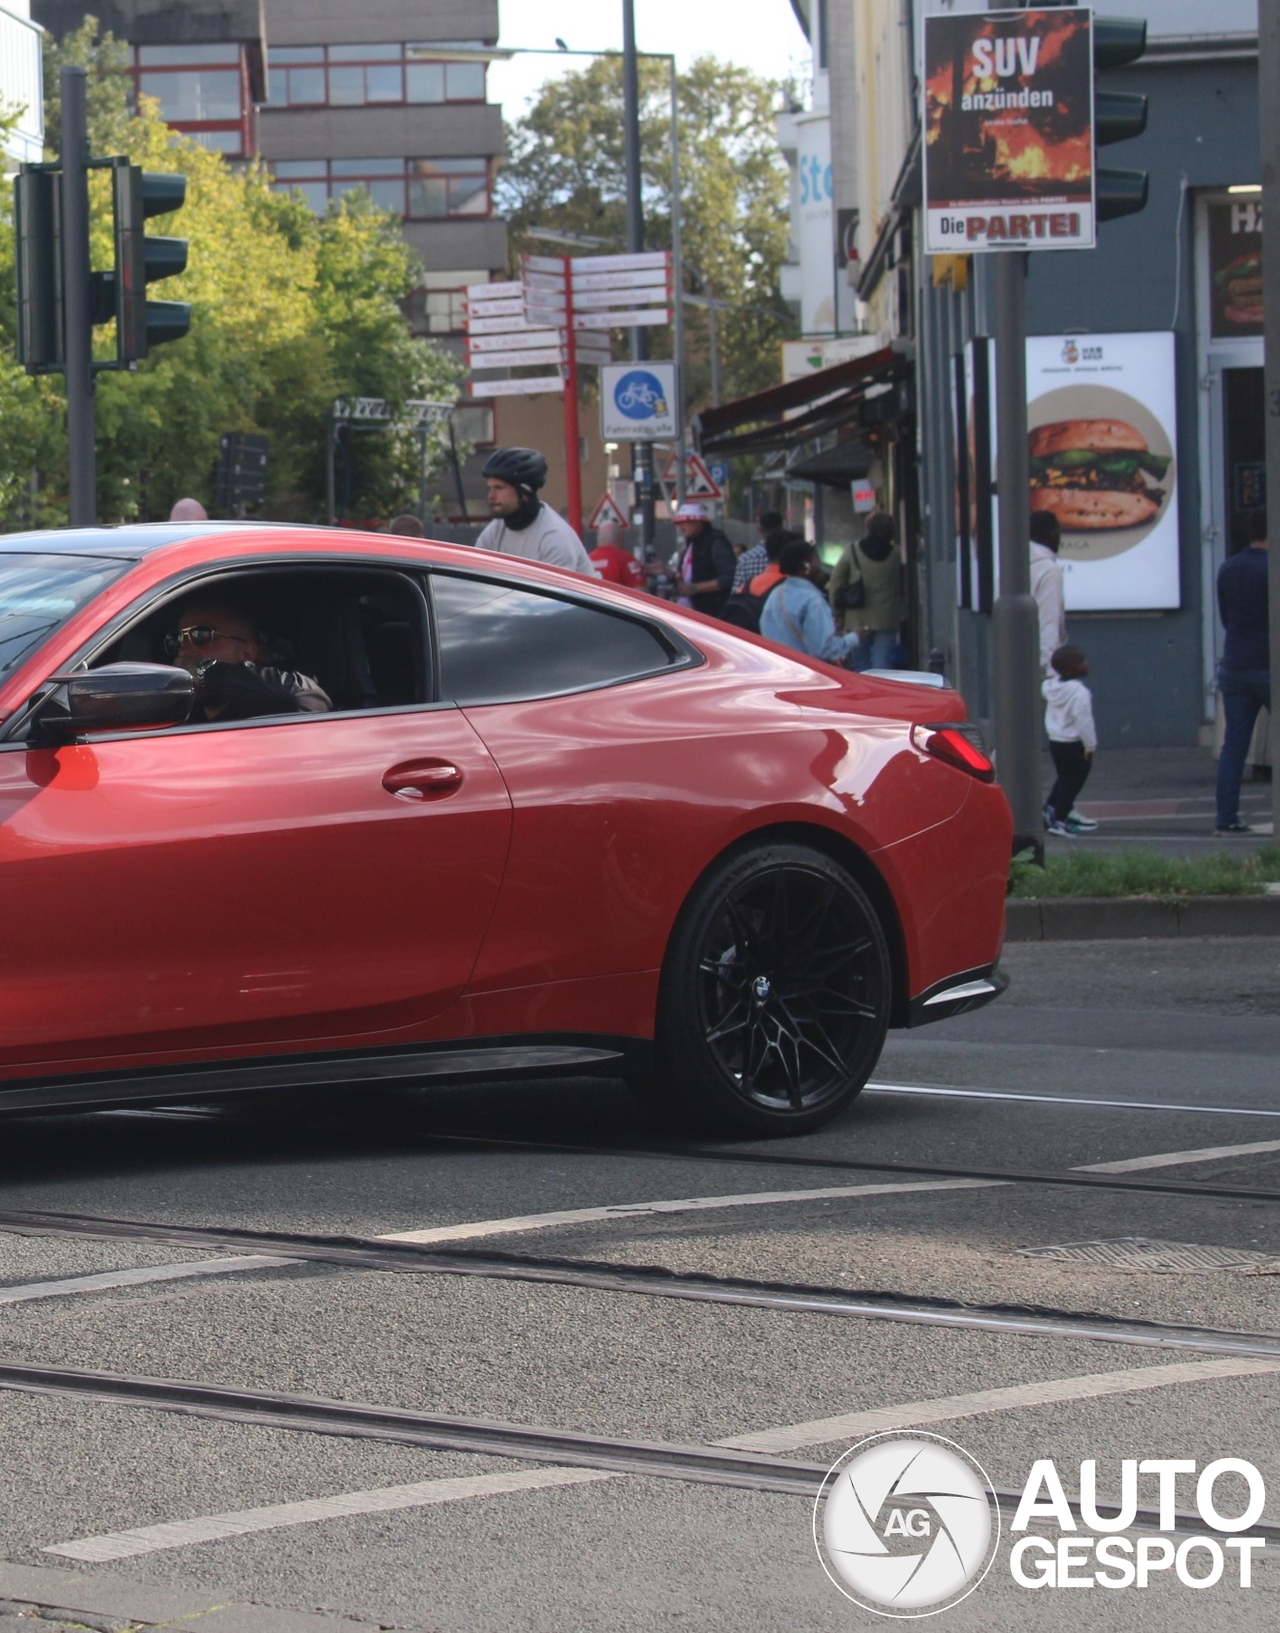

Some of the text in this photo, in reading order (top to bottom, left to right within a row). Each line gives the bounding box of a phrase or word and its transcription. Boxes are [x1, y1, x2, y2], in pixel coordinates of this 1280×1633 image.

[972, 36, 1040, 78] SUV
[961, 87, 1053, 111] anzünden
[940, 212, 1081, 242] Die PARTEI
